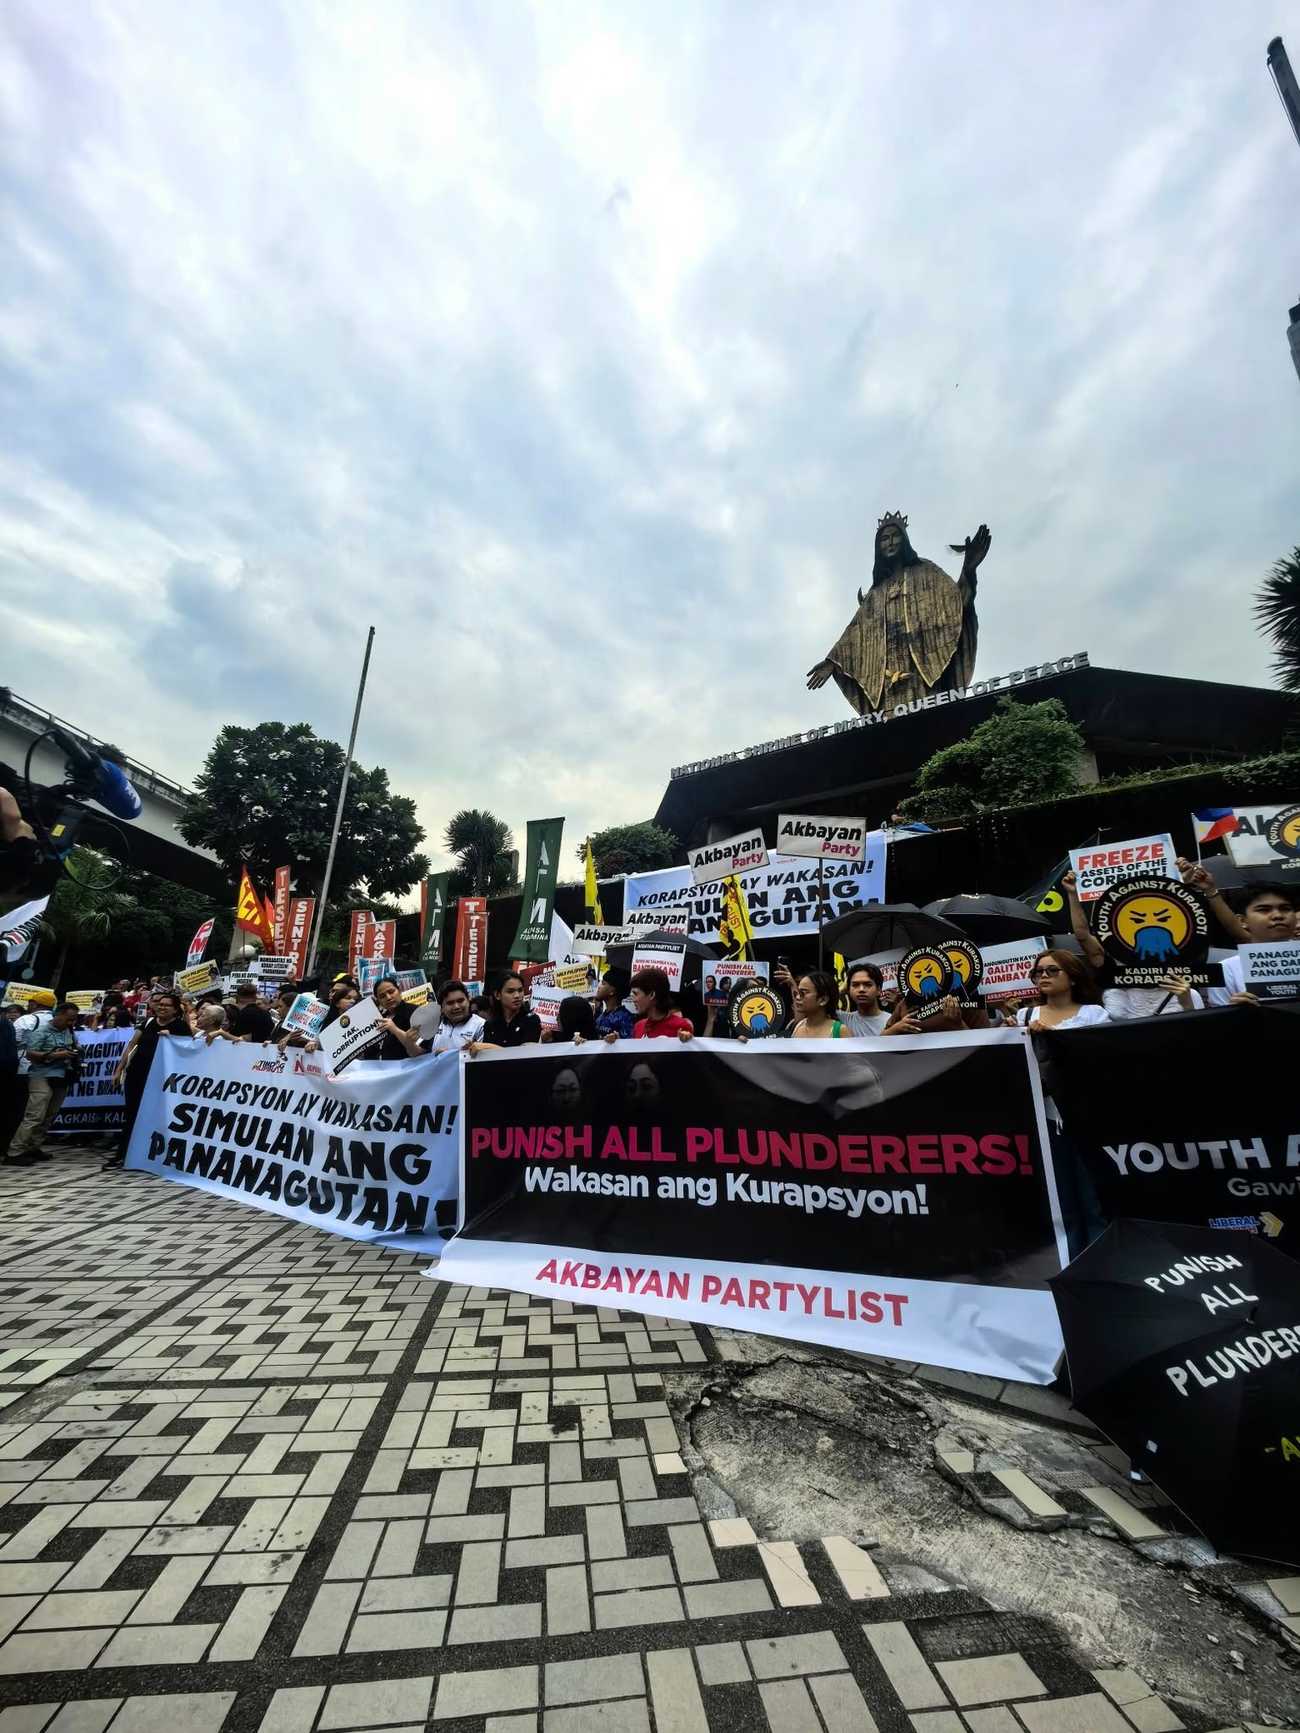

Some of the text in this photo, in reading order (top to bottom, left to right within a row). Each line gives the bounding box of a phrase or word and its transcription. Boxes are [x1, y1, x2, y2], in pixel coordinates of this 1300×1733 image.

[670, 651, 1091, 779] NATIONAL SHRINE OF MARY, QUEEN OF PEACE
[781, 821, 862, 841] Akbayan
[694, 836, 762, 868] Akbayan
[732, 851, 764, 869] Party
[821, 841, 860, 857] Party
[1078, 843, 1164, 870] FREEZE
[767, 859, 874, 888] WAKASAN!
[1080, 858, 1168, 879] ASSETS OF THE
[782, 880, 860, 906] ANG
[627, 913, 687, 926] Akbayan
[1096, 901, 1113, 941] YOUTH
[1109, 880, 1166, 902] AGAINST
[988, 961, 1031, 975] GALIT NG
[1114, 974, 1209, 985] KORAPSON!
[1125, 966, 1191, 975] KADIRI ANG
[737, 988, 762, 1003] AGAINST
[332, 1019, 380, 1058] CORRUPTION!
[163, 1072, 458, 1135] KORAPSYON AY WAKASAN!
[168, 1103, 432, 1186] SIMULAN ANG
[471, 1125, 1034, 1176] PUNISH ALL PLUNDERERS!
[1102, 1137, 1272, 1176] YOUTH
[524, 1165, 929, 1218] Wakasan ang Kurapsyon!
[1208, 1216, 1260, 1229] LIBERAL
[1143, 1254, 1243, 1293] PUNISH
[535, 1258, 909, 1326] AKBAYAN PARTYLIST
[1201, 1283, 1259, 1315] ALL
[1165, 1324, 1300, 1397] PLUNDER
